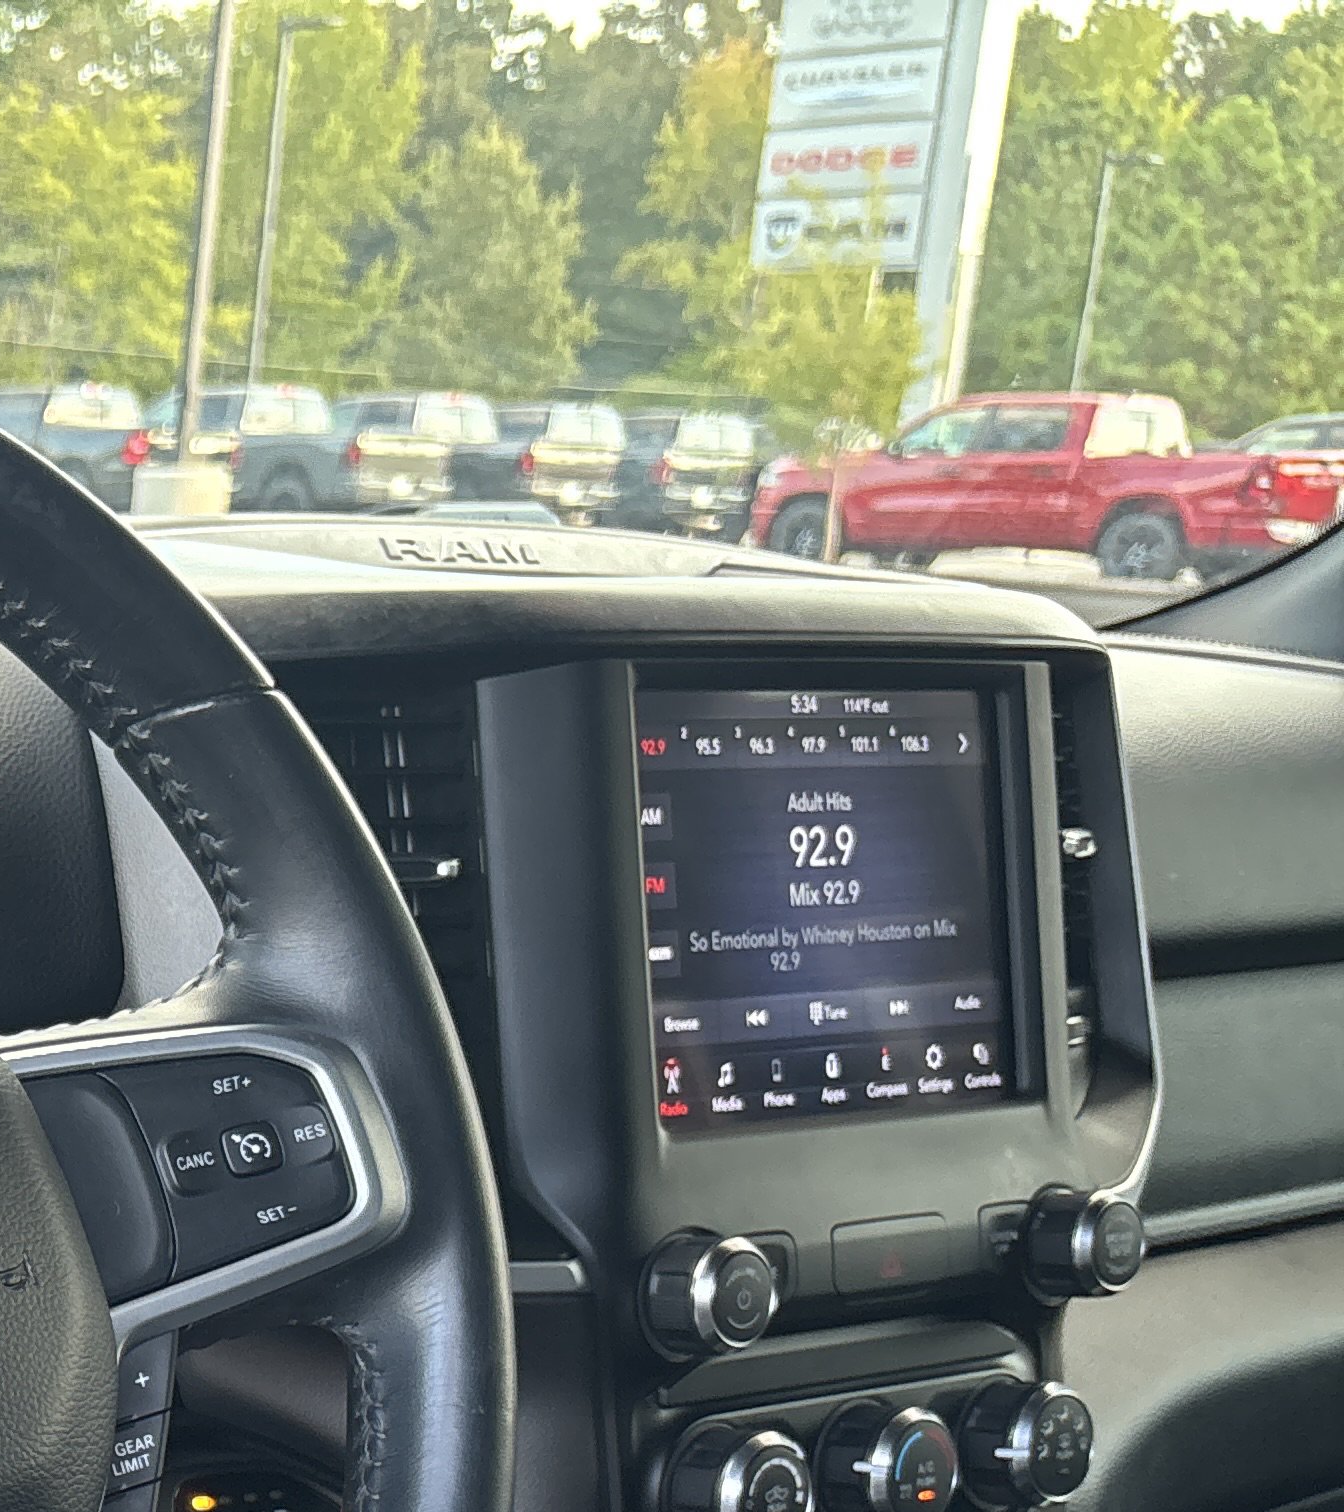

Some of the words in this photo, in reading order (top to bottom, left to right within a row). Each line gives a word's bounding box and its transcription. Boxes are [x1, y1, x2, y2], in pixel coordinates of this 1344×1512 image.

[378, 536, 541, 565] RAM
[790, 693, 820, 714] 5:34
[639, 739, 667, 756] 92.9
[695, 737, 722, 756] 95.5
[748, 736, 775, 755] 96.3
[801, 735, 827, 753] 97.9
[850, 735, 880, 753] 101.1
[787, 792, 824, 813] Adult
[825, 791, 853, 812] Hits
[640, 808, 663, 826] AM
[788, 823, 857, 868] 92.9
[644, 878, 667, 894] FM
[788, 881, 822, 907] Mix
[822, 879, 861, 905] 92.9
[689, 930, 709, 953] So
[712, 927, 779, 951] Emotional
[781, 927, 800, 950] by
[800, 923, 856, 947] Whitney
[856, 920, 912, 944] Houston
[913, 926, 932, 938] on
[932, 918, 959, 938] Mix
[769, 950, 802, 972] 92.9
[292, 1122, 328, 1144] RES
[175, 1150, 216, 1172] CANC
[114, 1433, 156, 1458] GEAR
[111, 1453, 152, 1478] LIMIT
